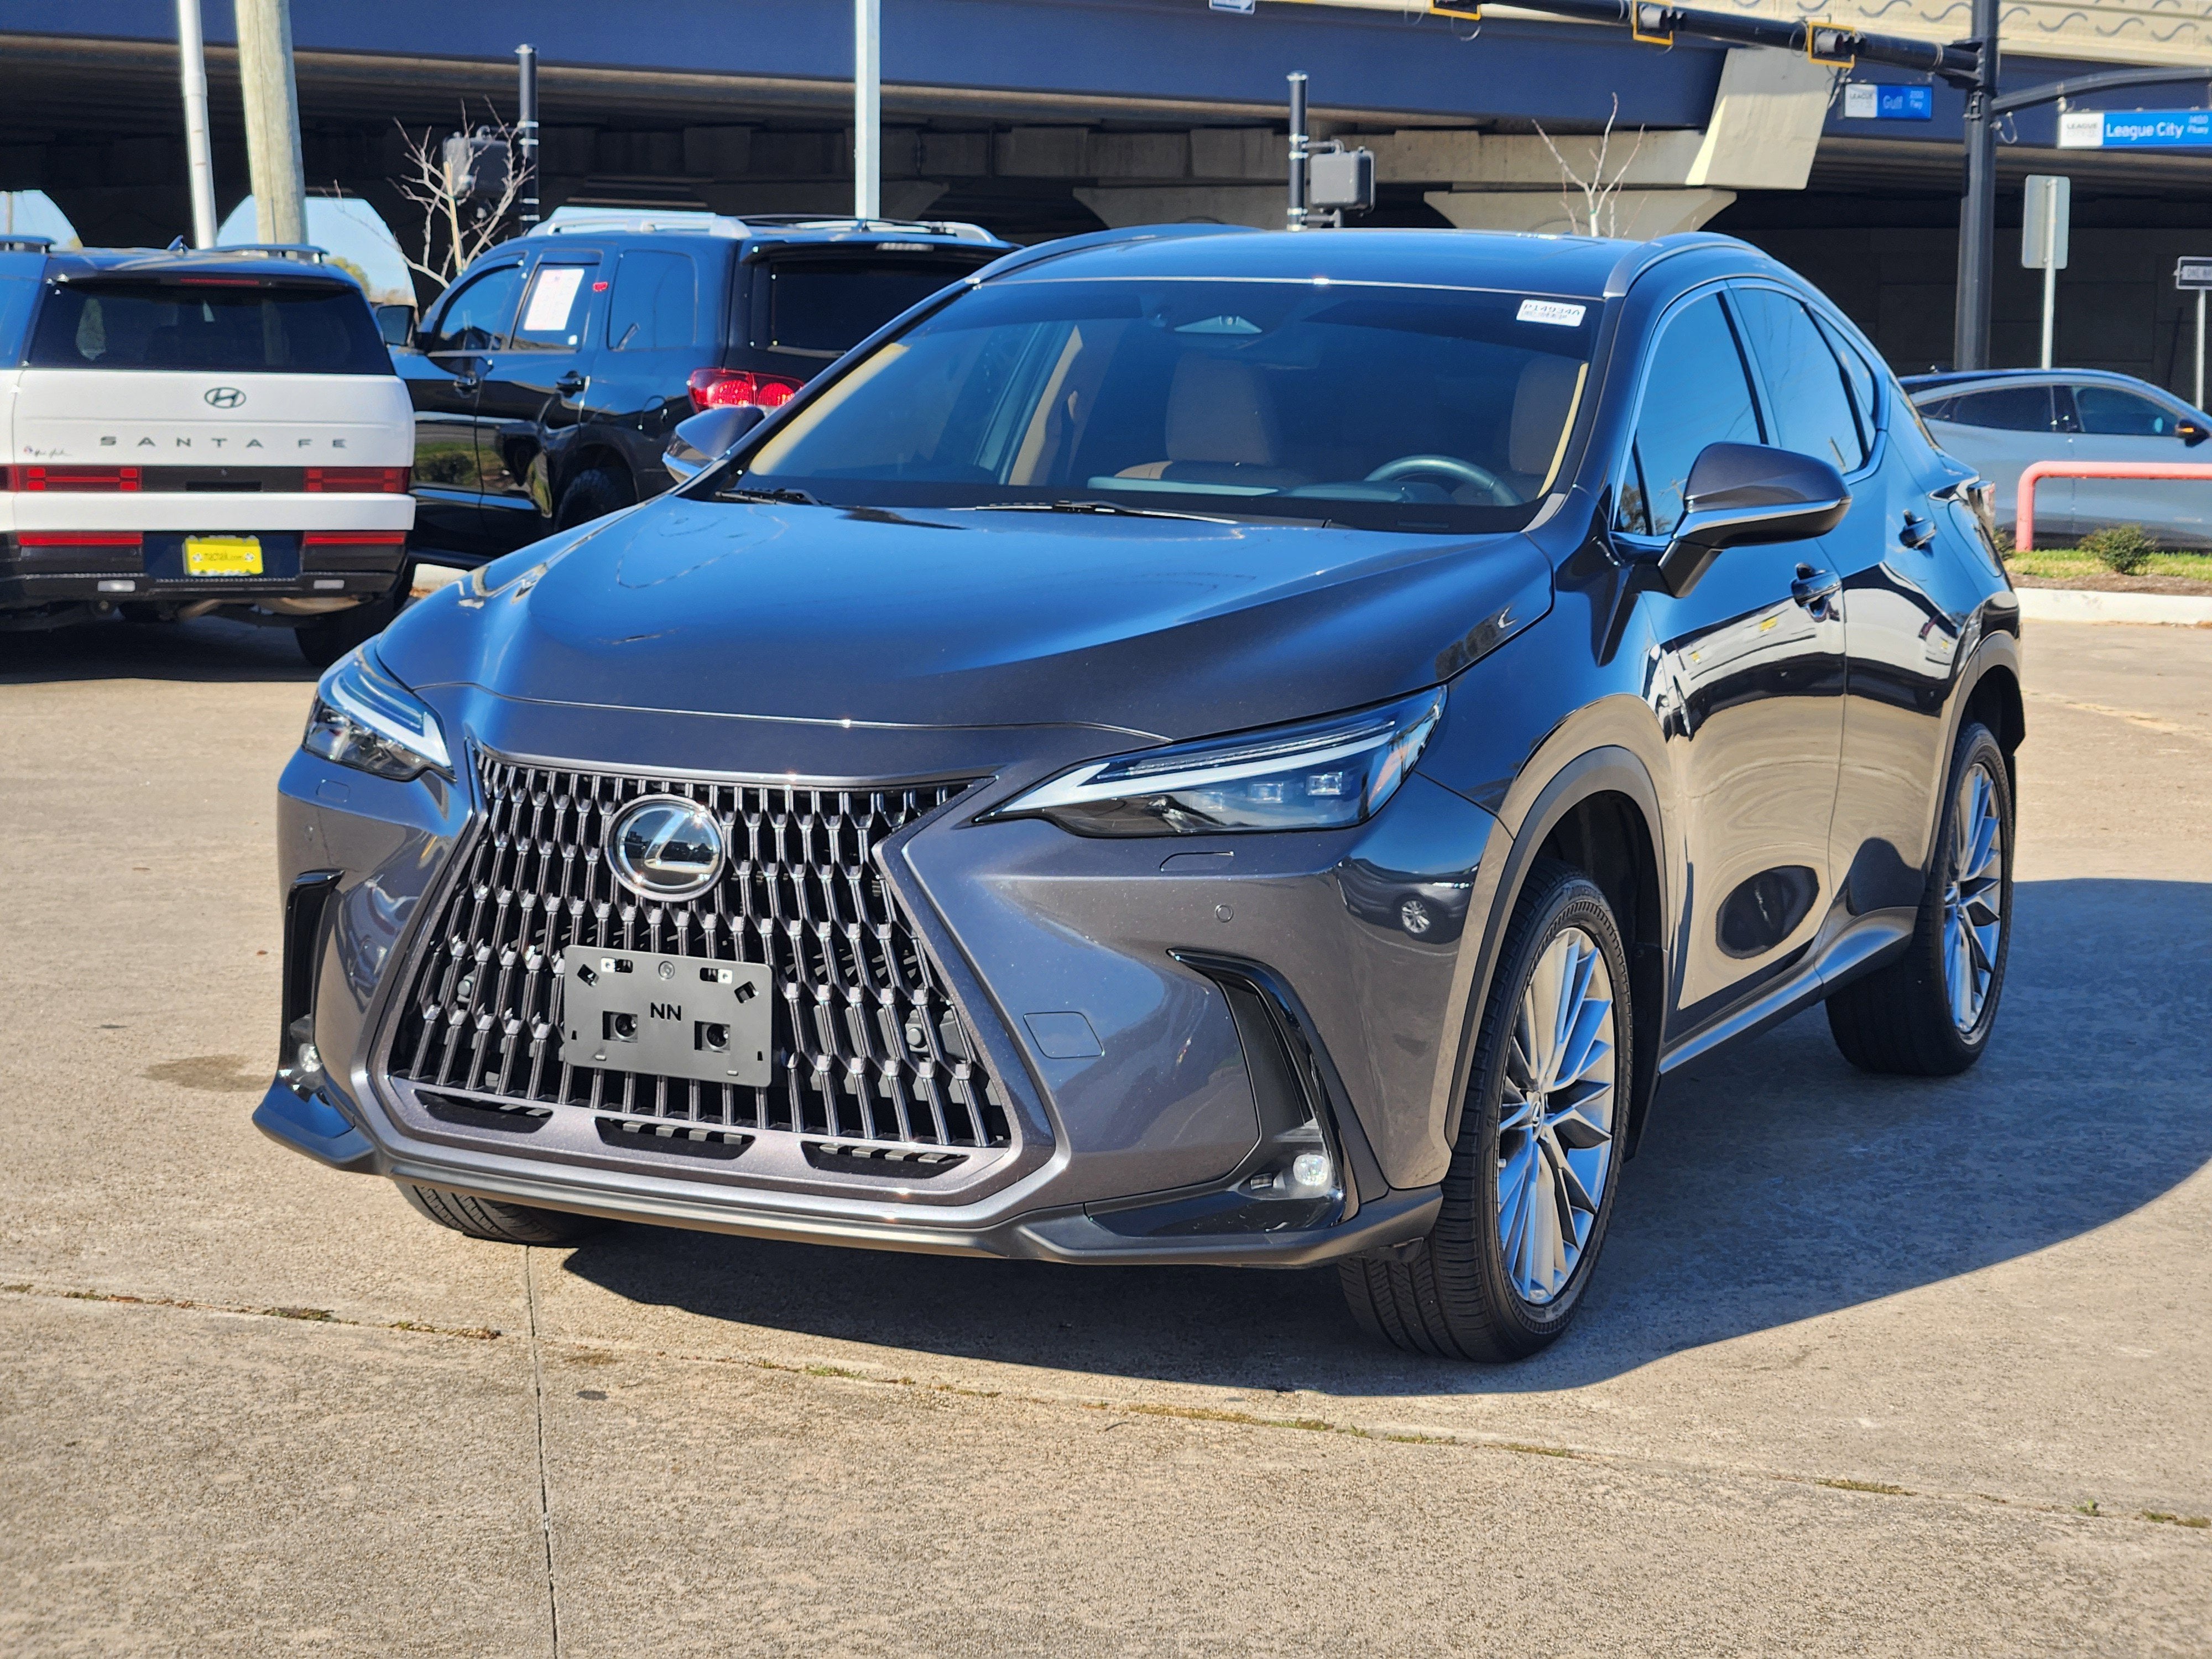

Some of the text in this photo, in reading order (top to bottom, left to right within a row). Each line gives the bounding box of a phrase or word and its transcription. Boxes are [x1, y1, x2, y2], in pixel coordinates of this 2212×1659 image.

[2106, 121, 2184, 141] League City
[100, 436, 347, 448] SANTA FE
[650, 1002, 681, 1021] NN
